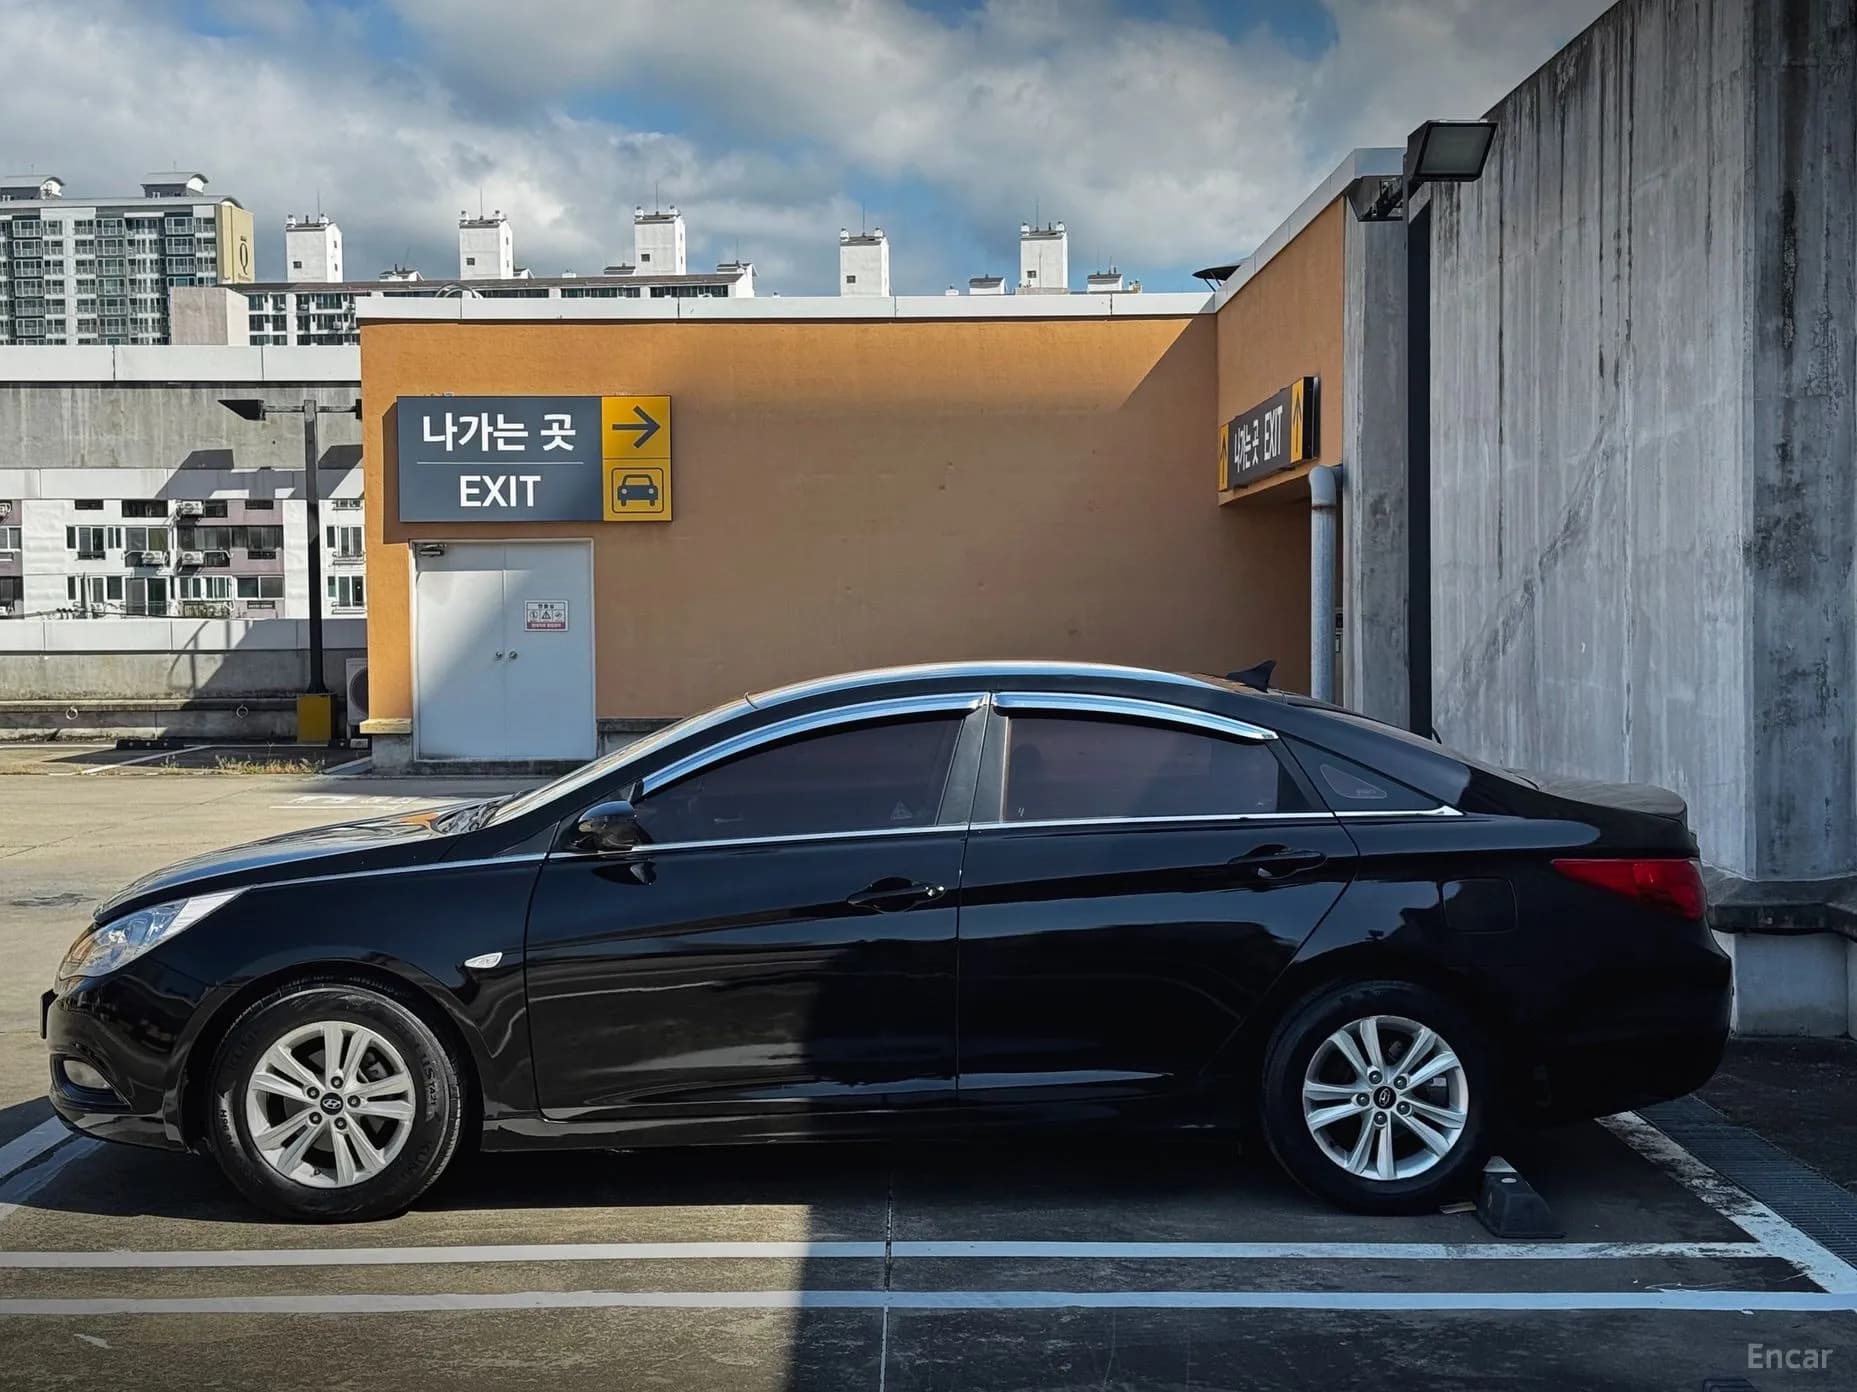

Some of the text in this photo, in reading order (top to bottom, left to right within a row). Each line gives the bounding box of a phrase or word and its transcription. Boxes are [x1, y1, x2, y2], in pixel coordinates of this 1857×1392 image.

[423, 412, 576, 452] 나가는 곳
[1234, 404, 1283, 473] 나가는 곳 EXIT
[459, 475, 541, 507] EXIT
